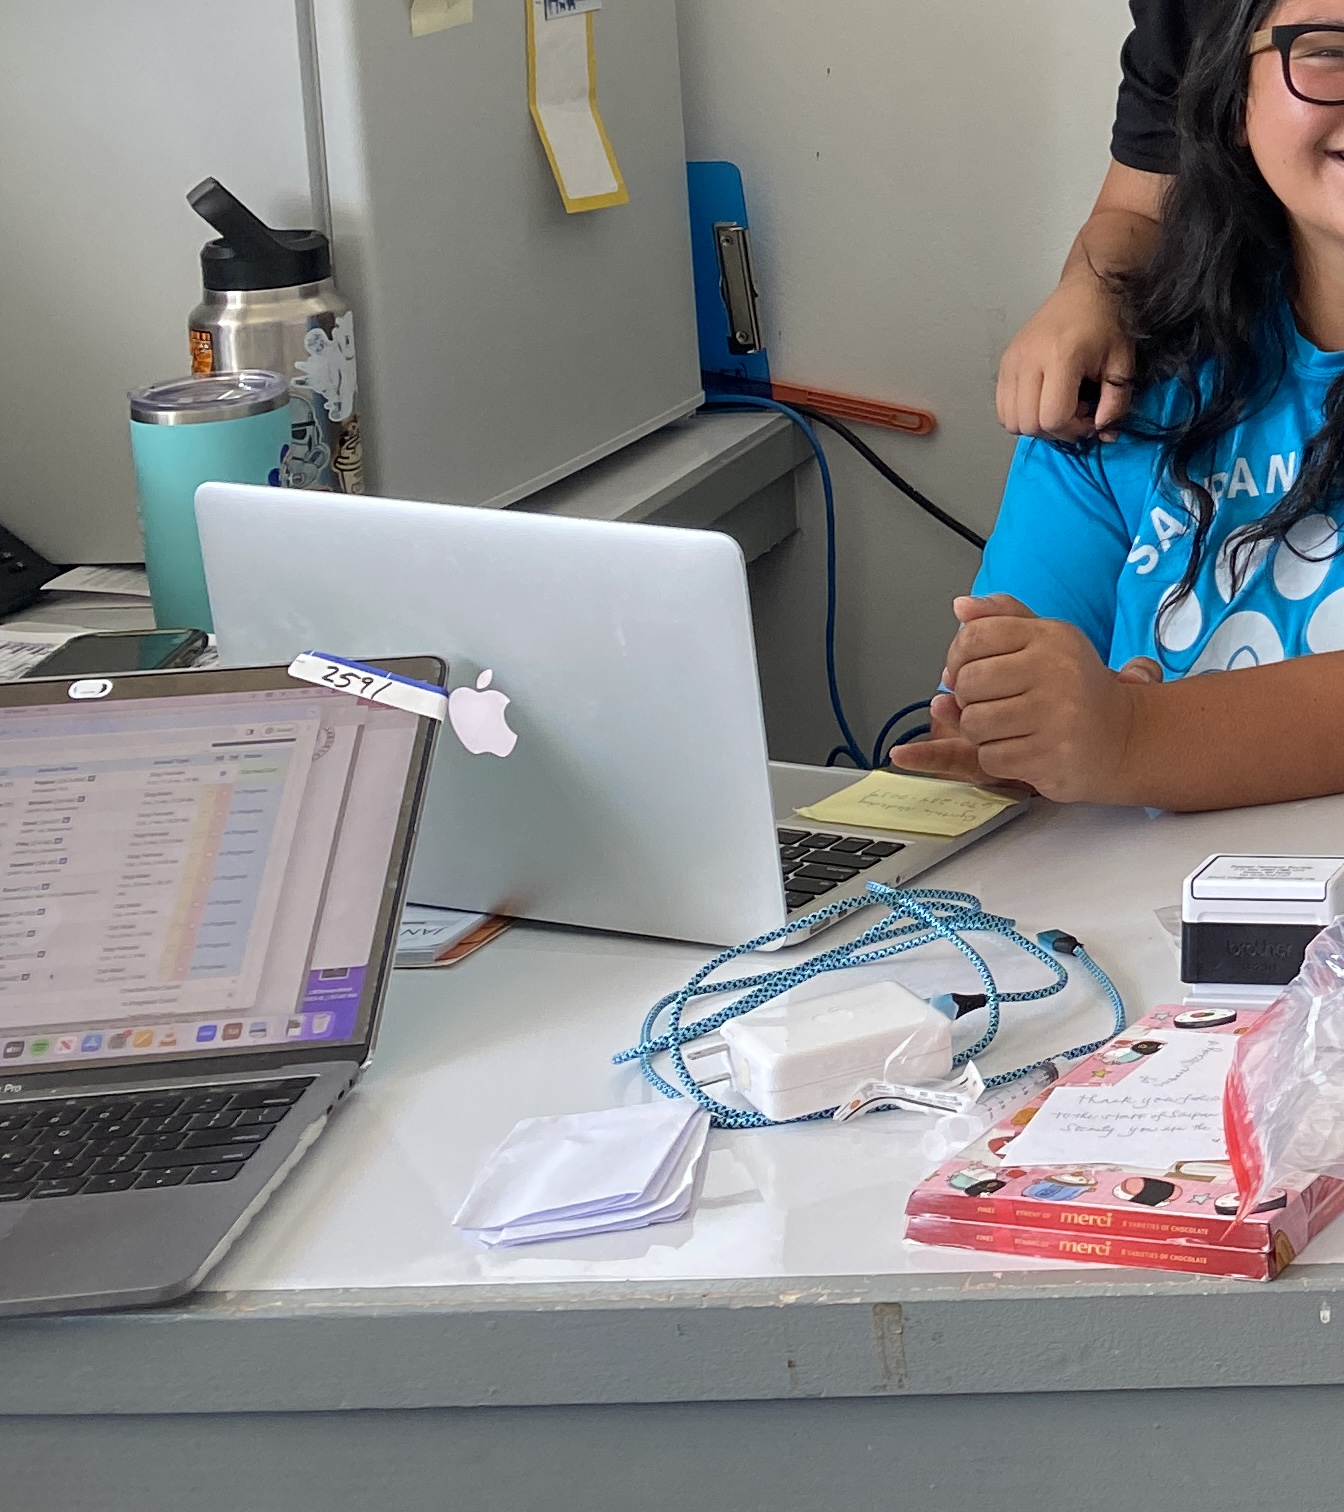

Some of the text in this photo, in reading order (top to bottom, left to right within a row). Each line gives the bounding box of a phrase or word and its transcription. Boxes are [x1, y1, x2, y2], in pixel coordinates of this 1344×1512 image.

[322, 666, 392, 699] 2591
[4, 1082, 22, 1093] Pro
[1060, 1212, 1112, 1228] merci
[1128, 1221, 1159, 1230] VARIETIES
[1160, 1224, 1169, 1232] OF
[1170, 1225, 1210, 1236] CHOCOLATE
[1058, 1240, 1112, 1256] merci
[1127, 1250, 1158, 1259] VARIETIES
[1170, 1254, 1208, 1264] CHOCOLATE
